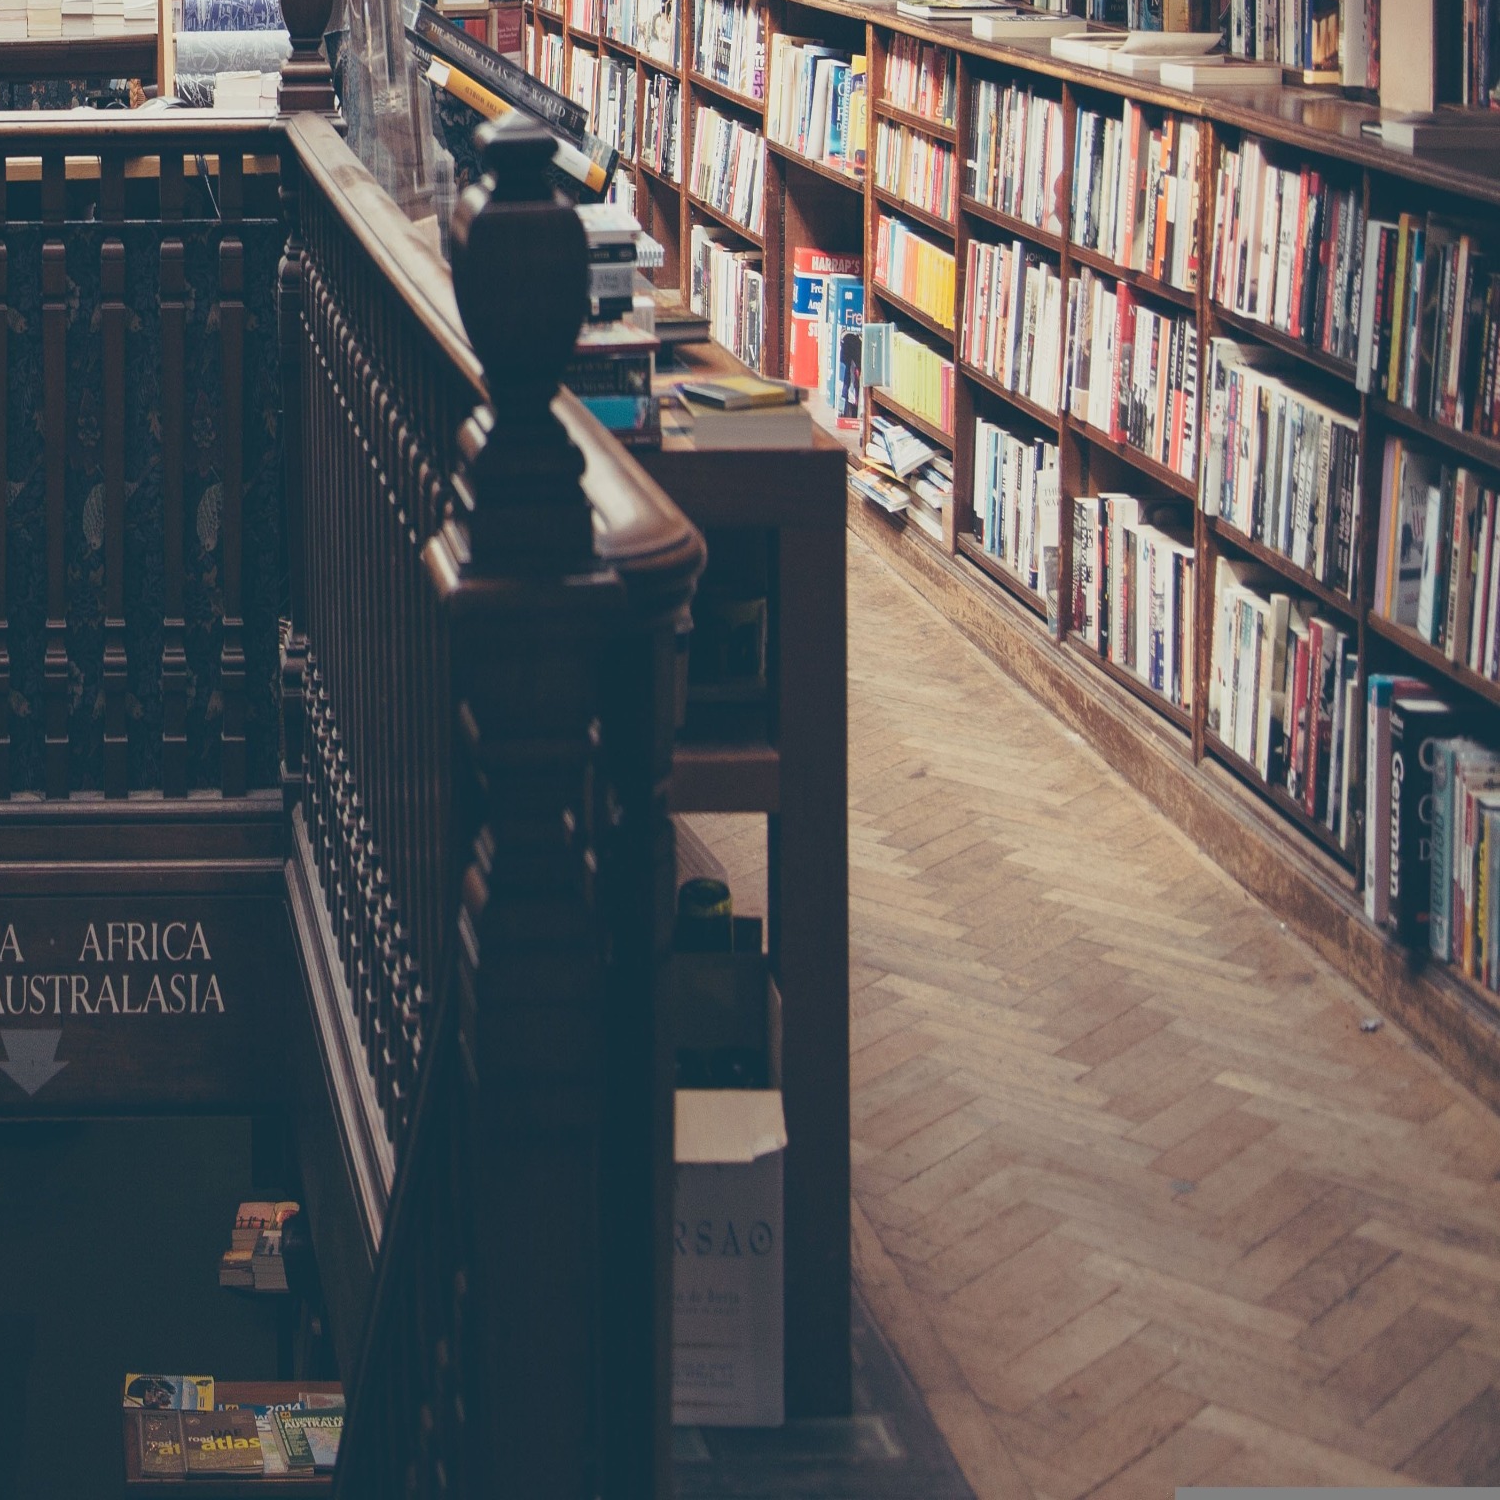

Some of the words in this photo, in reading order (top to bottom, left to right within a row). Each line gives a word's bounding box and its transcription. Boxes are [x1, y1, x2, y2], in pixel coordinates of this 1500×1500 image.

[477, 51, 509, 79] ATLAS
[530, 91, 566, 119] WORLD
[1123, 157, 1136, 235] Bismarck
[811, 255, 861, 274] HARRAP'S
[1318, 443, 1330, 479] LONG
[1389, 751, 1404, 898] German
[78, 921, 212, 962] AFRICA
[265, 1401, 302, 1414] 2014
[283, 1418, 345, 1430] AUSTRALIA
[187, 1434, 214, 1444] road
[200, 1434, 262, 1453] atlas
